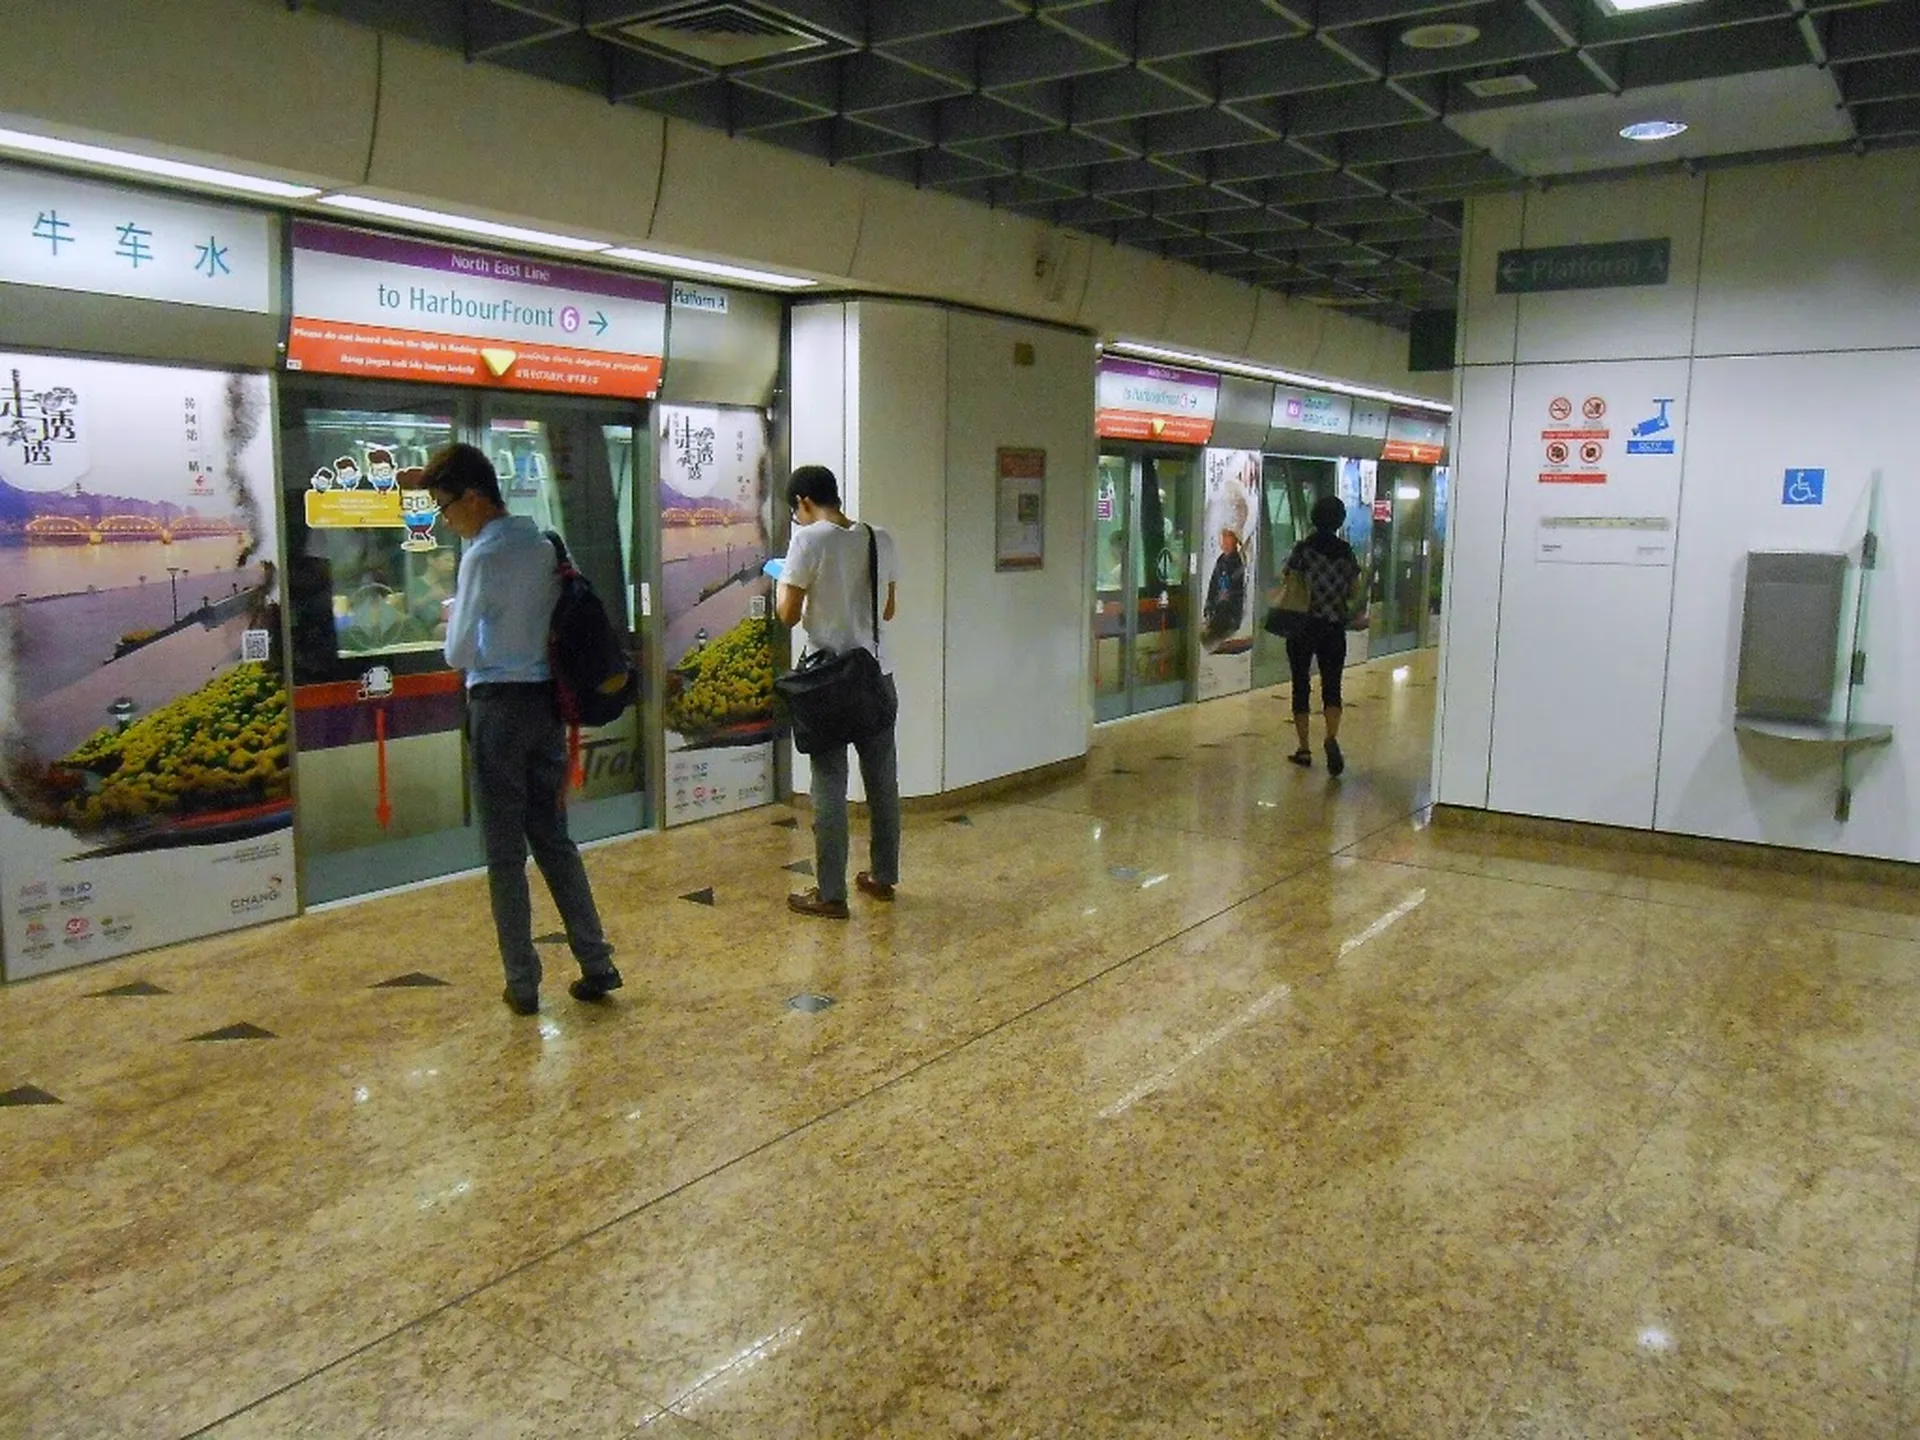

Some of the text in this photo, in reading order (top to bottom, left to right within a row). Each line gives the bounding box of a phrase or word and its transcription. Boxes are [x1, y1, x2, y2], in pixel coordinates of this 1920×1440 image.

[32, 210, 230, 277] 牛车水
[451, 255, 550, 281] North East Line
[378, 284, 400, 309] to
[409, 286, 554, 327] HarbourFront
[674, 288, 715, 308] Platform
